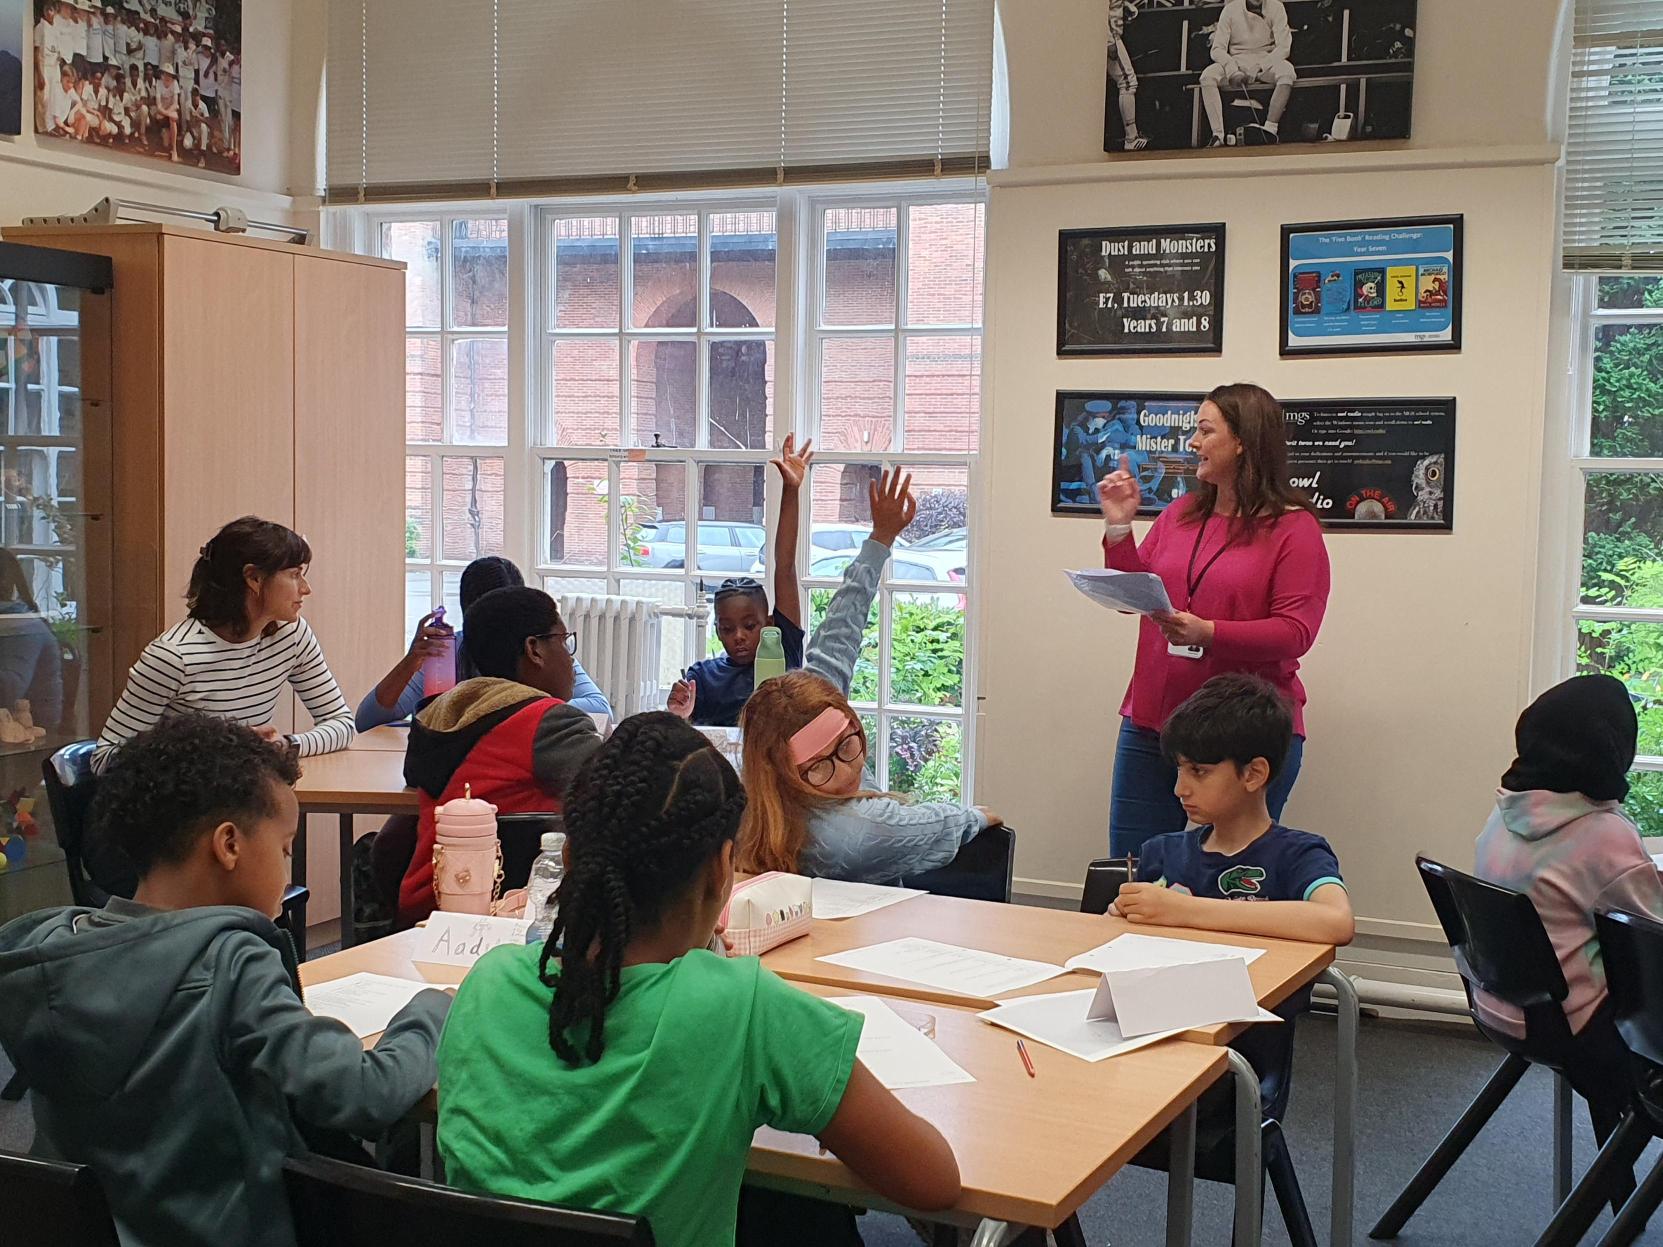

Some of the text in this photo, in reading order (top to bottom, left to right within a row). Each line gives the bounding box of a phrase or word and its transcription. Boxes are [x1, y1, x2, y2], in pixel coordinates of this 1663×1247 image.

[1101, 237, 1216, 256] Dust and Monsters
[1365, 233, 1390, 242] Reading
[1098, 290, 1210, 310] E7, Tuesdays 1.30
[1122, 316, 1210, 333] Years 7 and 8
[1140, 409, 1198, 429] Goodnigh
[1286, 412, 1310, 426] mgs
[1136, 434, 1196, 452] Mister To
[1288, 471, 1321, 488] owl
[1346, 488, 1397, 512] ON THE AIR
[432, 925, 487, 956] Aad
